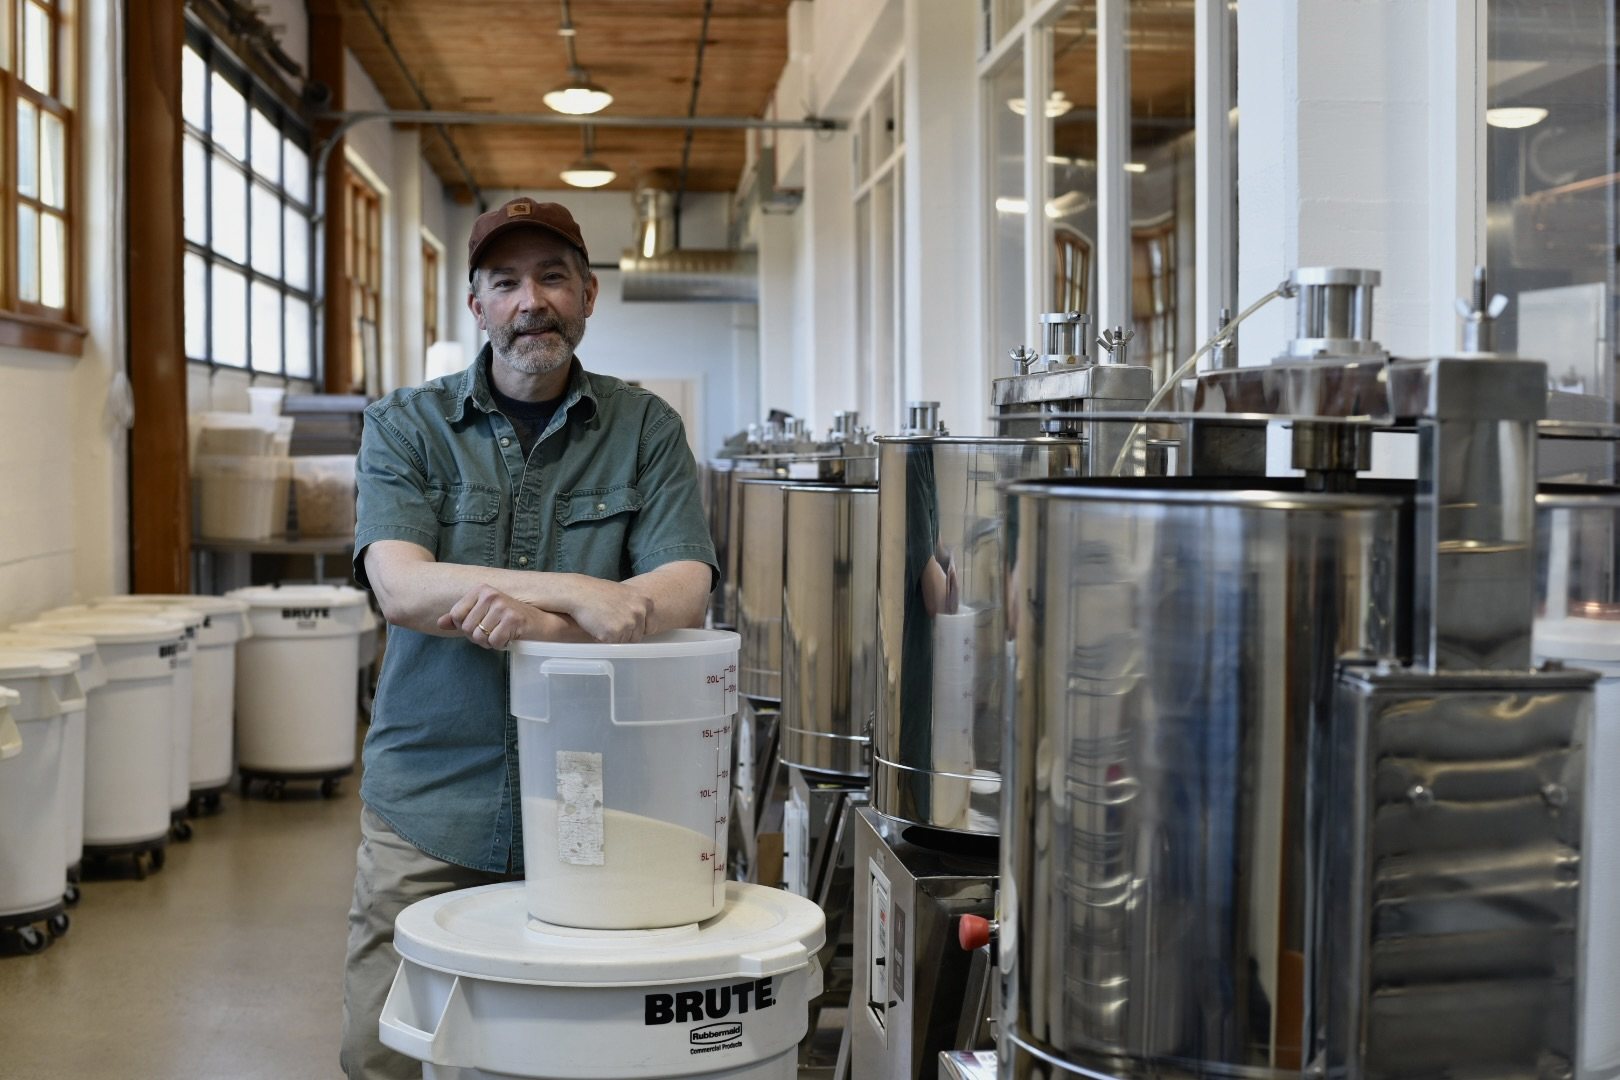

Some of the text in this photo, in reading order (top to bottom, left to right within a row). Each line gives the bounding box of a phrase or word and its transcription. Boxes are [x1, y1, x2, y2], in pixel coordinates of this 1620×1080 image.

[706, 674, 719, 684] 20L
[702, 729, 713, 738] 15L
[700, 789, 711, 798] 10L
[701, 852, 709, 861] 5L
[692, 1025, 740, 1041] Rubbermaid
[690, 1040, 743, 1055] Commercial Products
